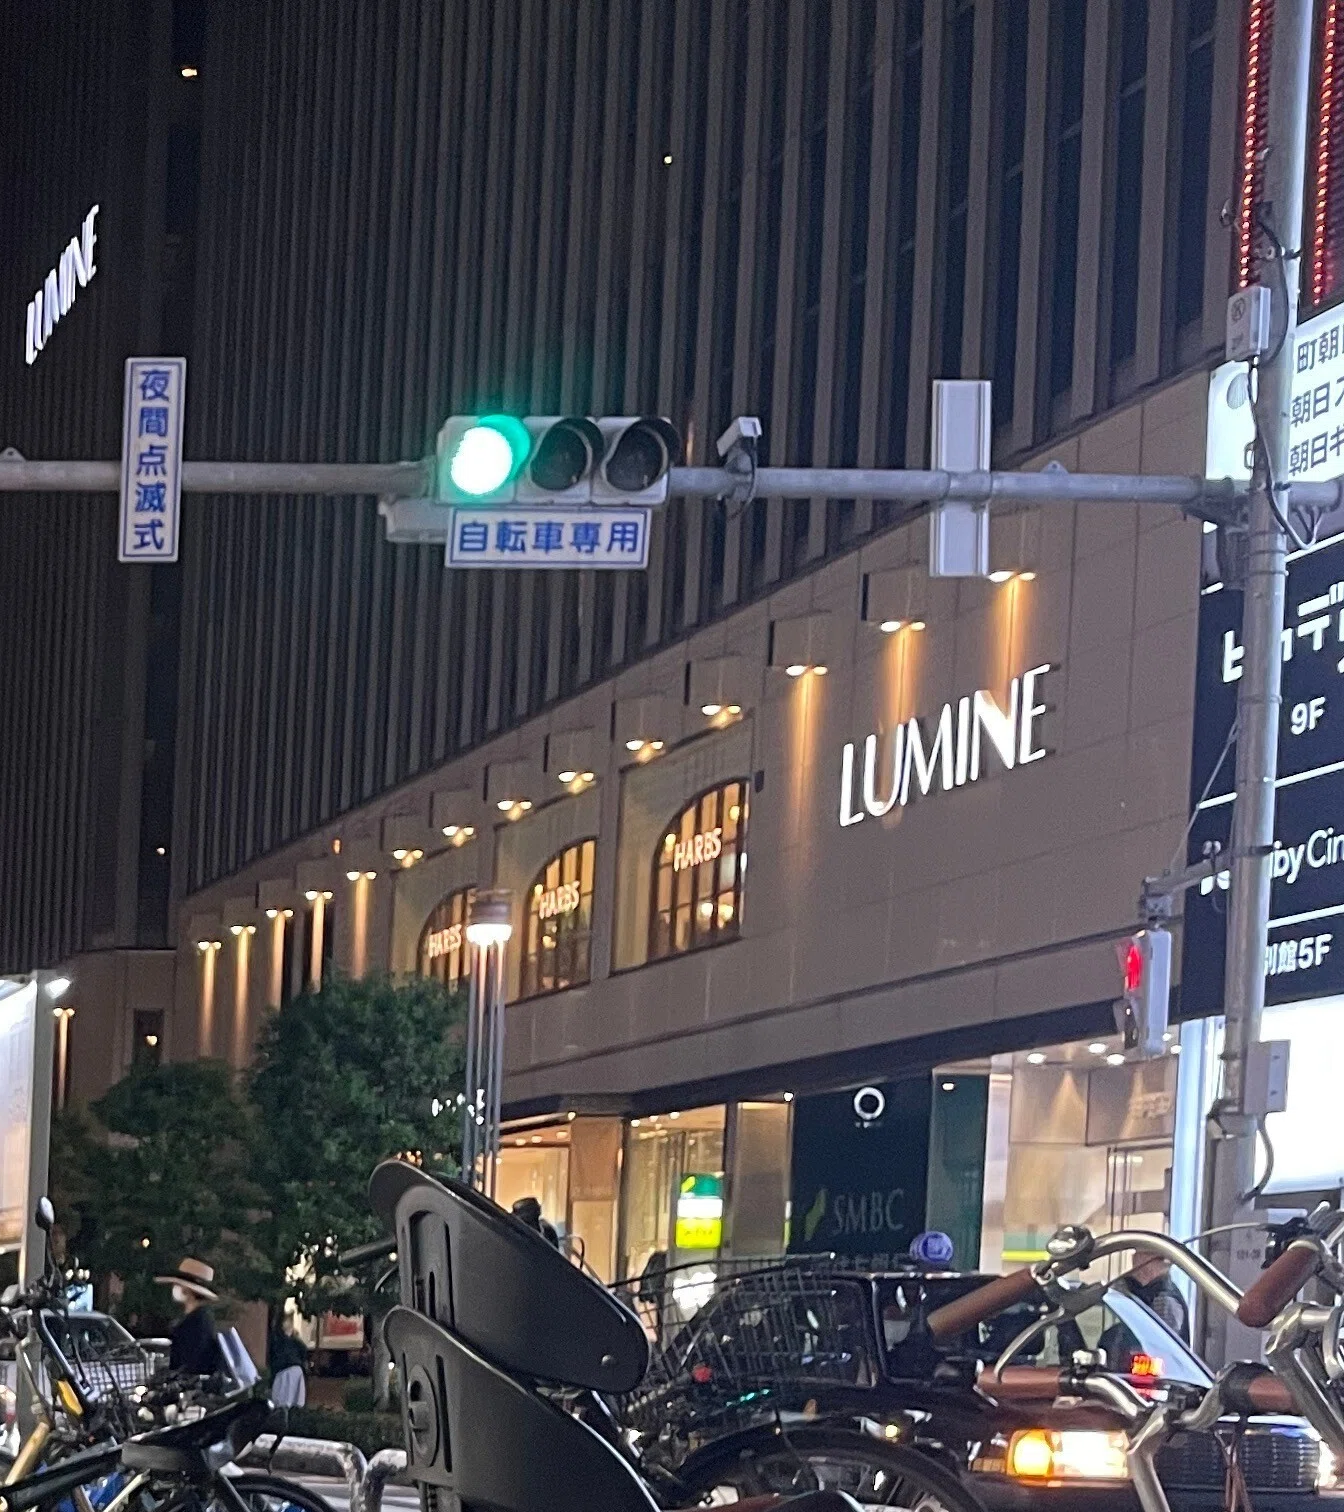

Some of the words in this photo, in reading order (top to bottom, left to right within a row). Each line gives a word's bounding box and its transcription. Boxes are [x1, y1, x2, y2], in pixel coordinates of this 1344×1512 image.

[25, 204, 99, 365] LUMINE
[1296, 325, 1344, 374] 町朝
[132, 368, 172, 552] 夜間点滅式
[457, 520, 640, 554] 自転車専用
[1290, 696, 1326, 735] 9F
[838, 664, 1052, 828] LUMINE
[674, 828, 722, 872] HARBS
[540, 880, 580, 919] HARBS
[833, 1188, 905, 1236] SMBC
